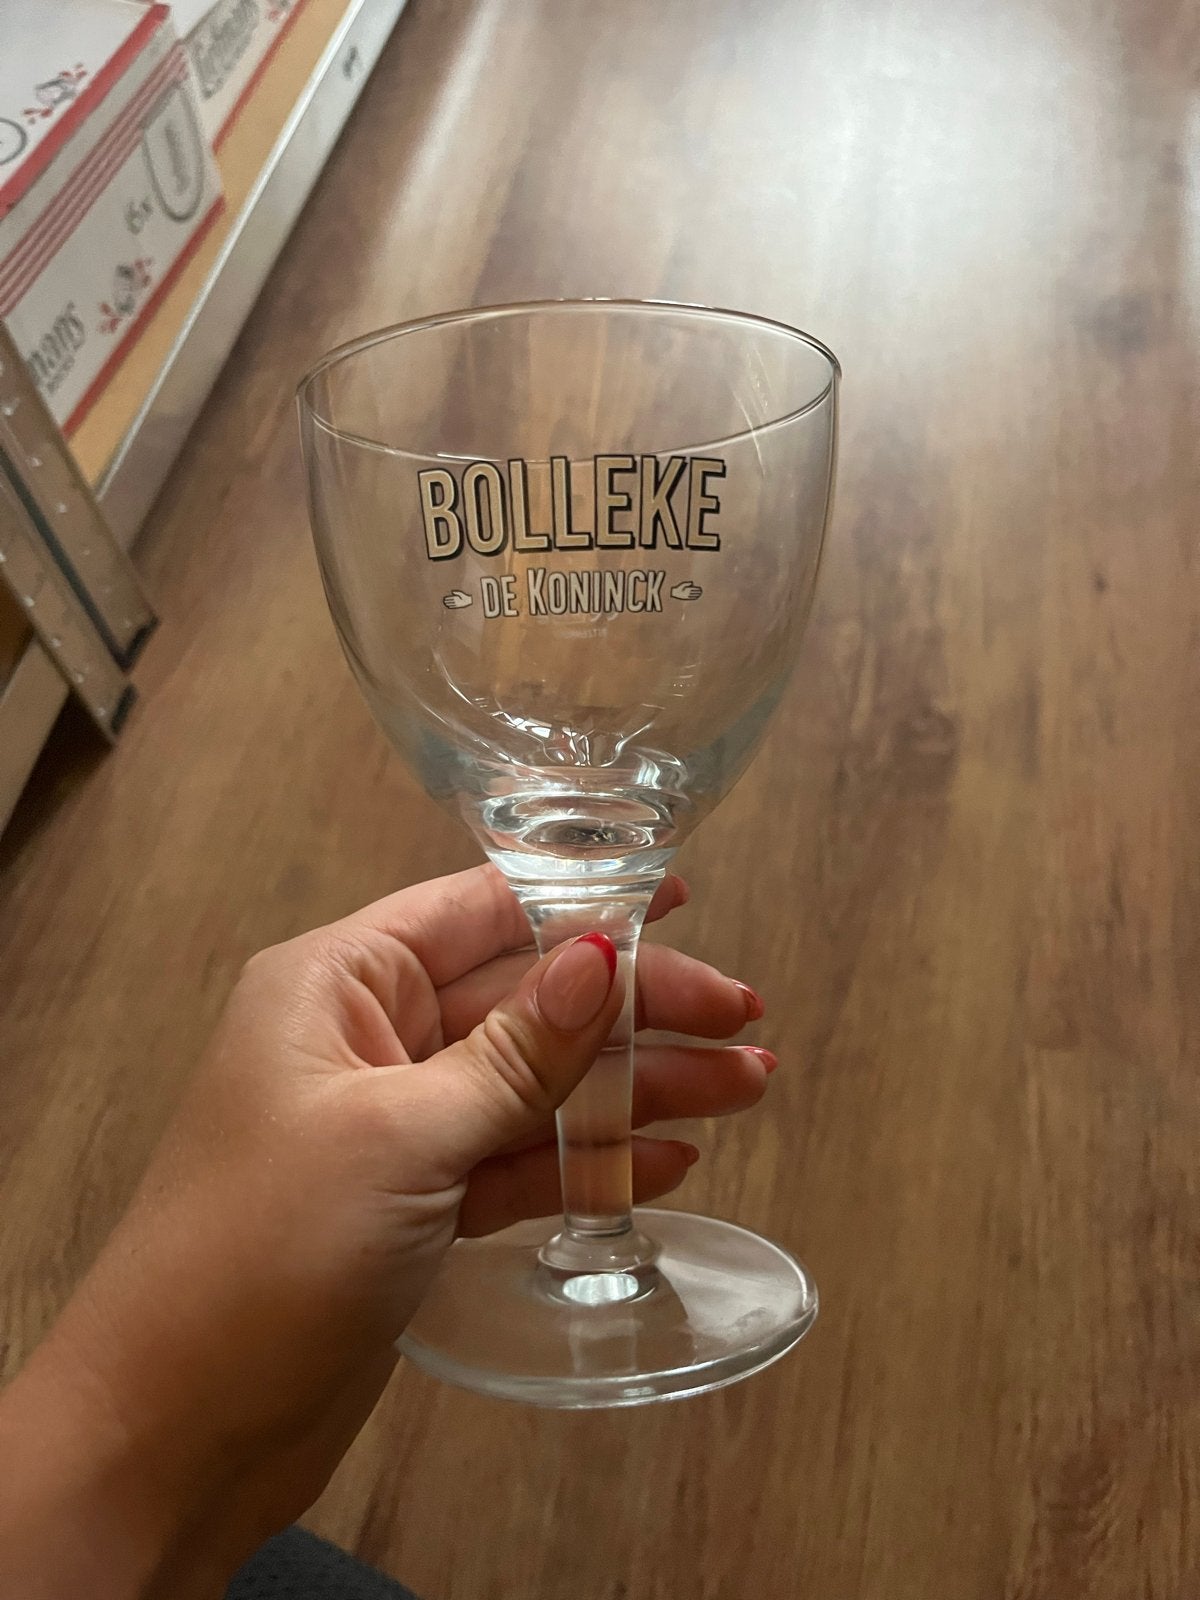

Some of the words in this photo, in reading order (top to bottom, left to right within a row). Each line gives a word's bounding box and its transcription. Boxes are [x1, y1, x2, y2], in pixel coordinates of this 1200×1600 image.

[417, 454, 727, 561] BOLLEKE
[480, 575, 519, 619] DE
[526, 568, 665, 616] KONINCK
